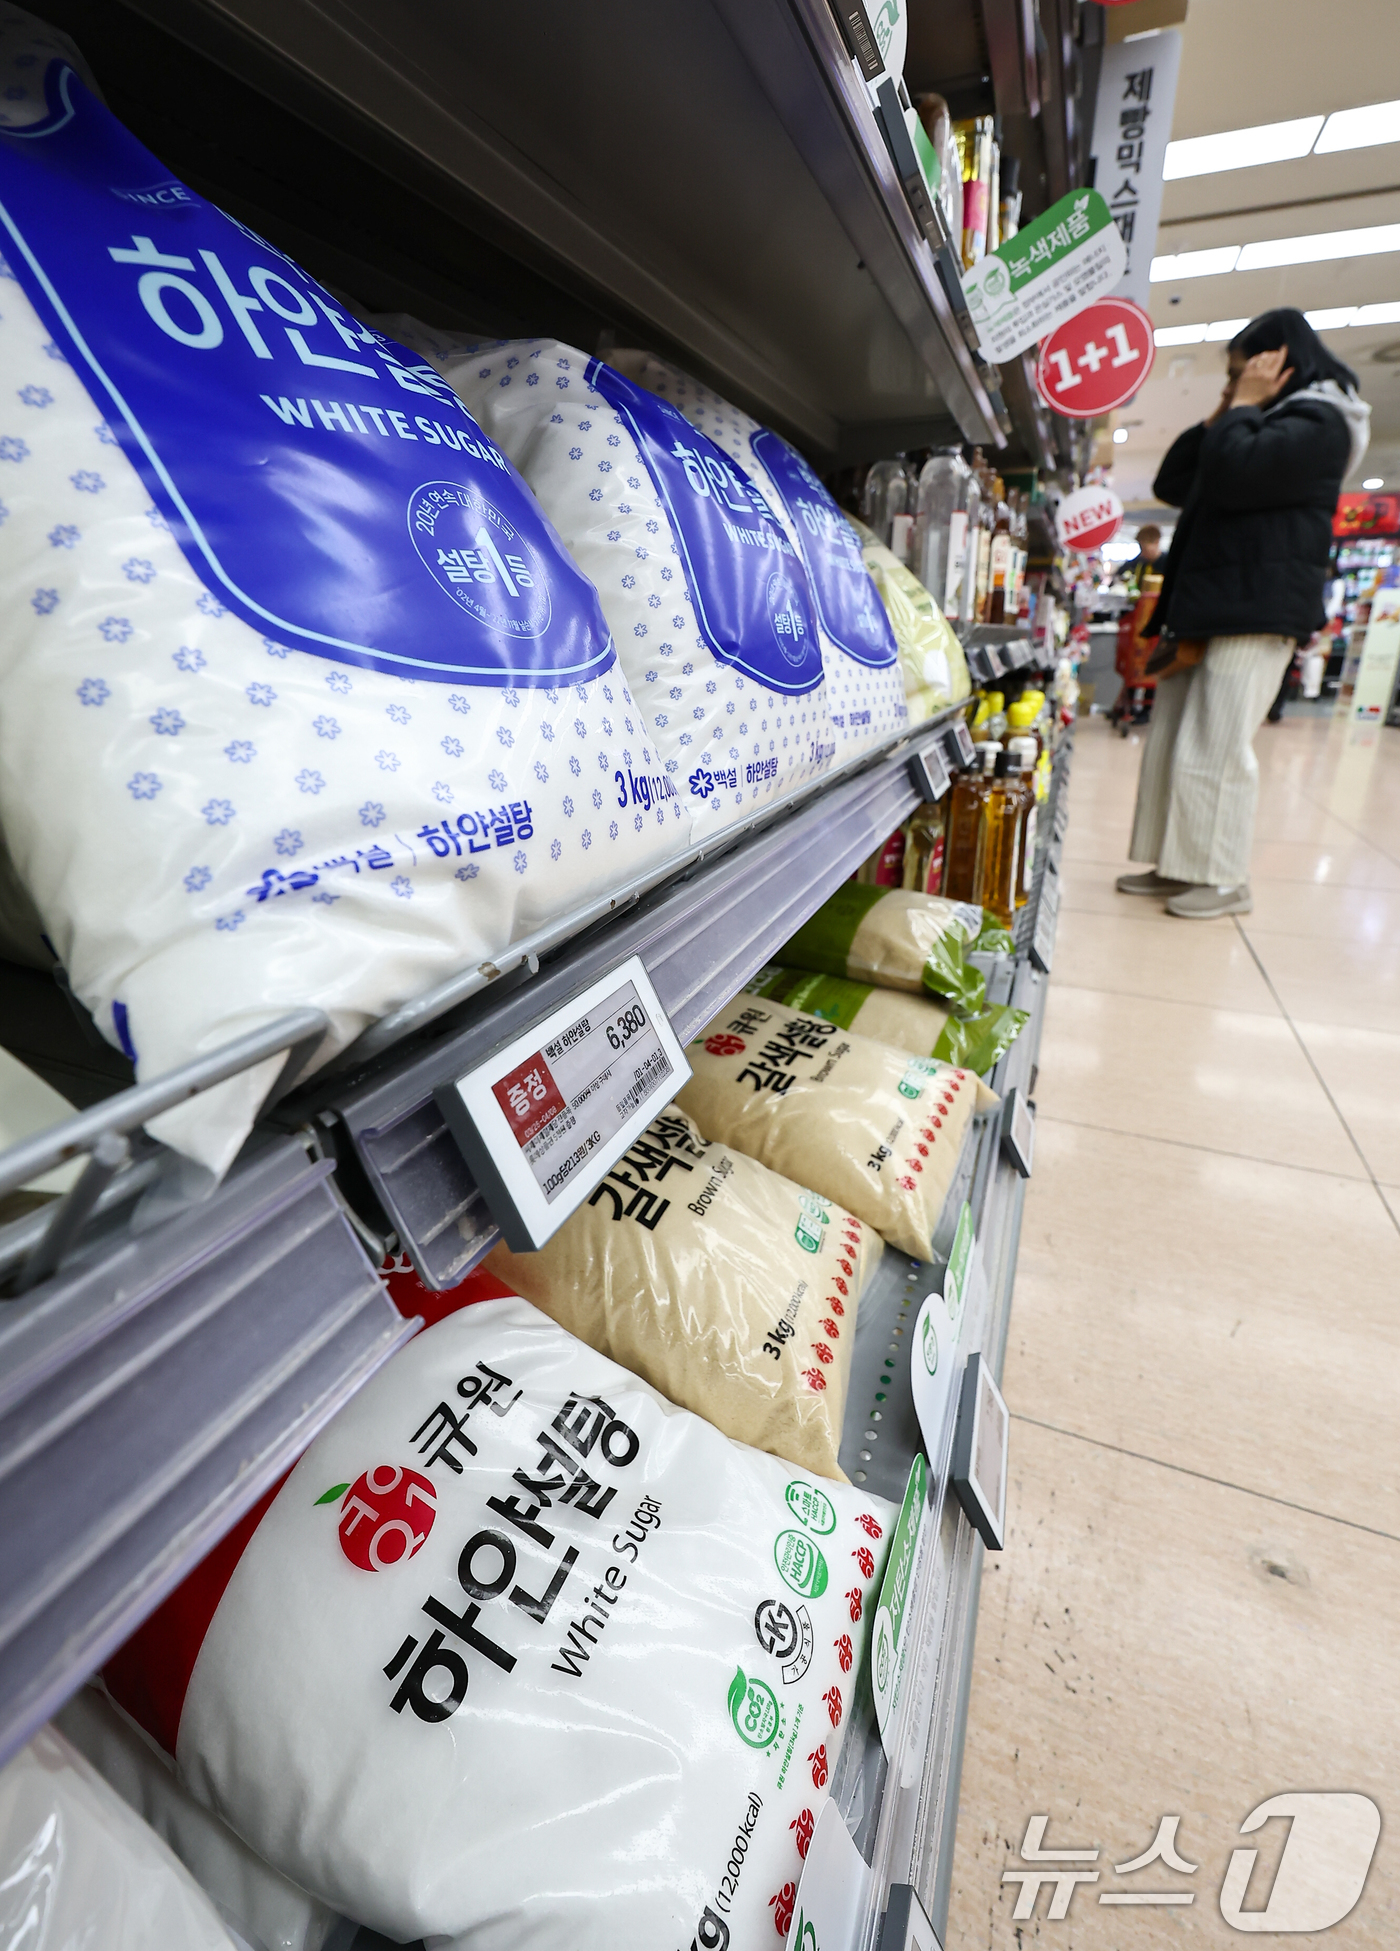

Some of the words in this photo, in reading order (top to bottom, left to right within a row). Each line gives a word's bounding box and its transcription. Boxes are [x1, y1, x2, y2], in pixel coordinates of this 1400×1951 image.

[1009, 209, 1090, 278] 녹색제품
[1048, 322, 1140, 394] 1+1
[259, 393, 419, 440] WHITE
[413, 416, 512, 477] SUGAR
[457, 490, 514, 541] 대한민국
[722, 522, 768, 549] WHITE
[1064, 498, 1112, 535] NEW
[714, 767, 737, 790] 백설
[746, 757, 779, 784] 하얀설탕
[415, 801, 535, 860] 하얀설탕
[545, 1041, 565, 1060] 백설
[561, 1018, 592, 1047] 하얀설탕
[605, 1004, 647, 1051] 6,380
[726, 1008, 773, 1035] 큐원
[507, 1067, 548, 1117] 증정
[688, 1176, 723, 1217] Brown
[409, 1360, 524, 1475] 큐원
[802, 1491, 812, 1516] 스마트
[810, 1496, 820, 1522] HACCP
[382, 1391, 640, 1724] 하얀설탕
[780, 1533, 797, 1572] 안전관리인증
[790, 1539, 807, 1582] HACCP
[550, 1566, 627, 1678] White
[612, 1494, 663, 1564] Sugar
[745, 1693, 765, 1732] CO2
